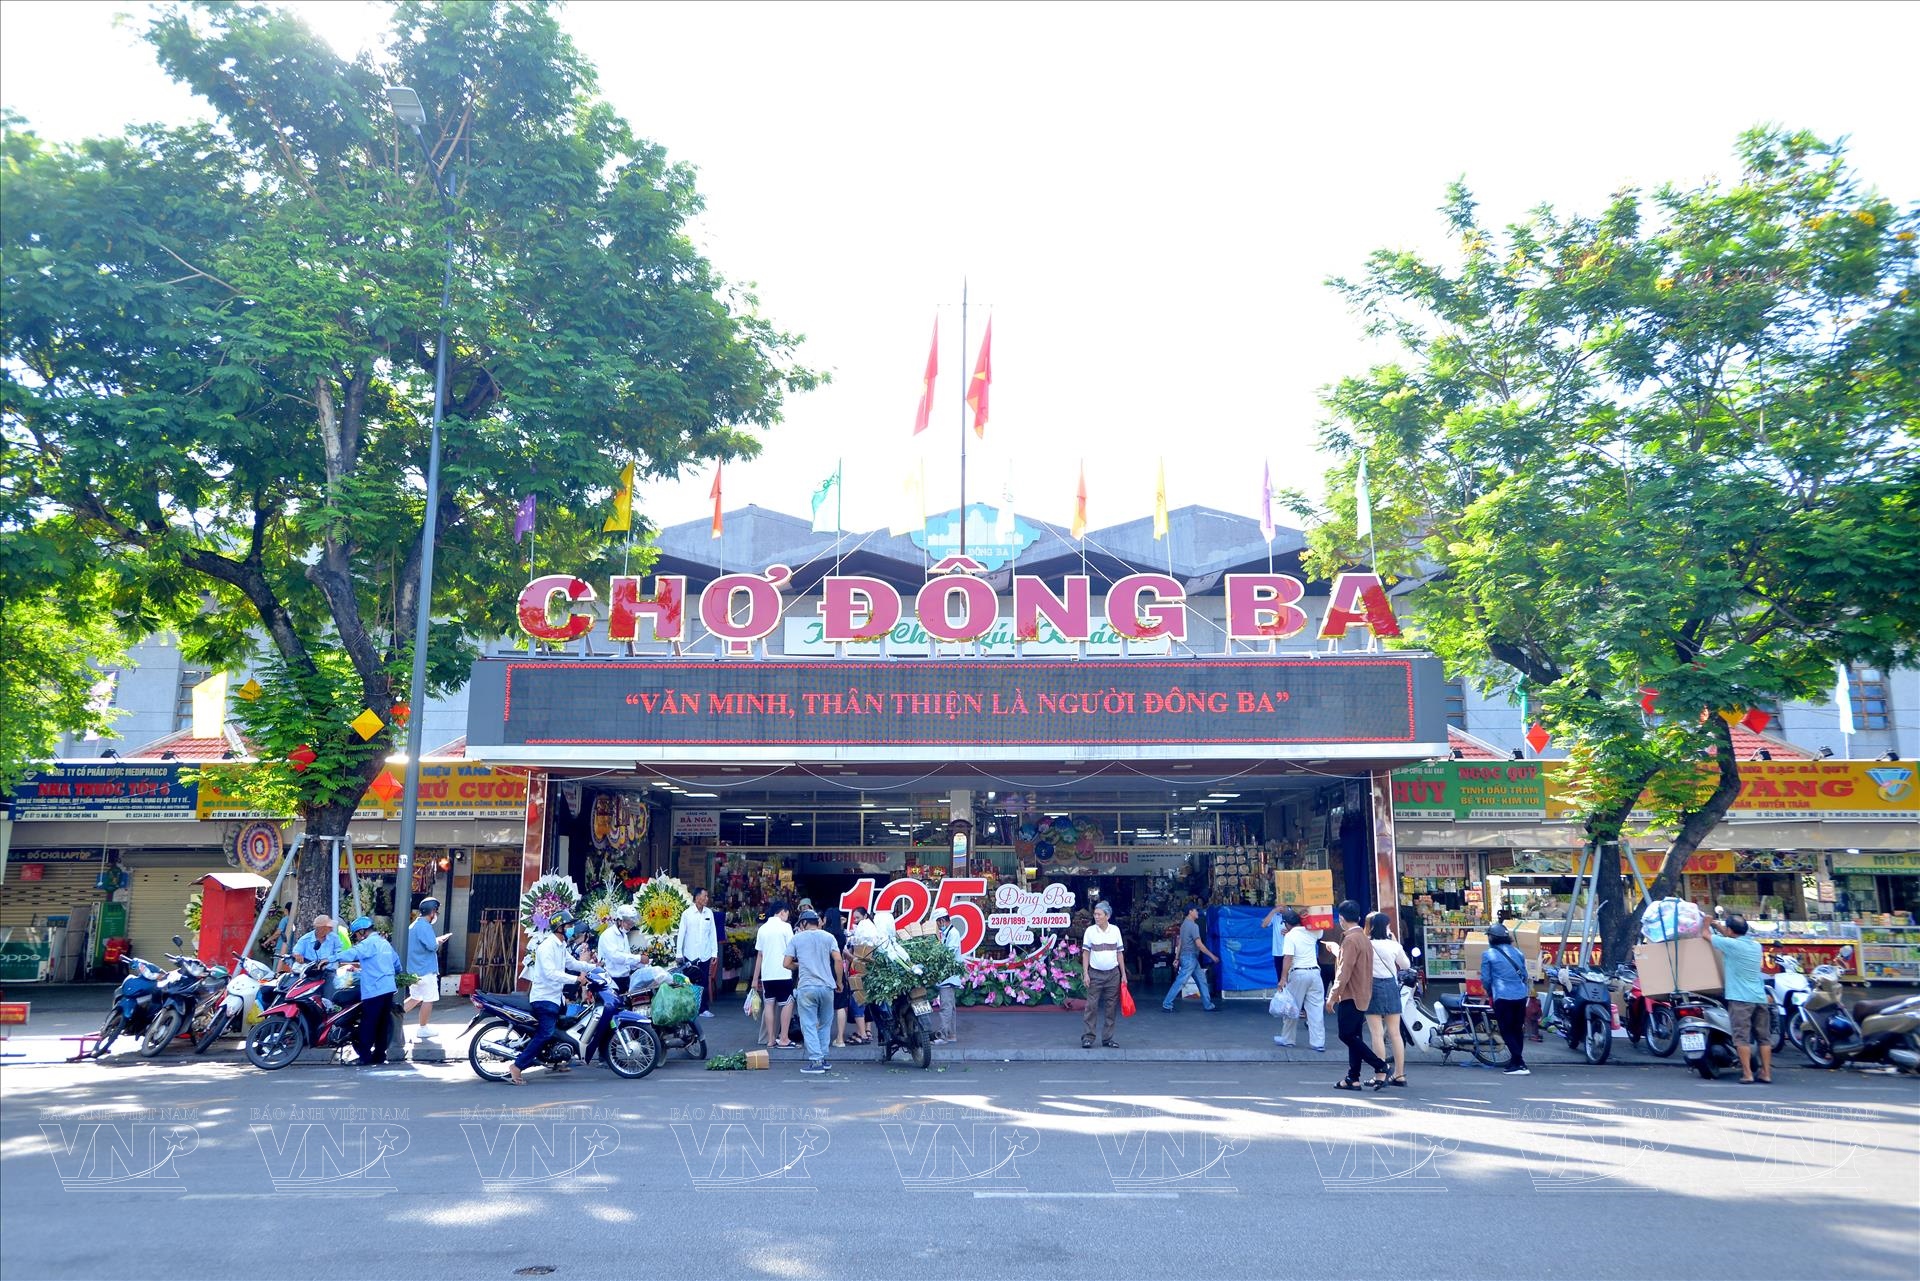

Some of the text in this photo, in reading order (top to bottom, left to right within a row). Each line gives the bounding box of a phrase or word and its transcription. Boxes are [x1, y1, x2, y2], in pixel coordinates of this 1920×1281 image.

[517, 554, 1402, 655] CHỢ ĐÔNG BA
[708, 693, 795, 719] MINH,
[802, 688, 883, 714] THÂN
[890, 690, 983, 720] THIỆN
[992, 688, 1029, 714] LÀ
[1038, 687, 1136, 714] NGƯỜI
[1143, 686, 1229, 713] ĐÔNG
[75, 778, 125, 796] THUỐC
[1459, 767, 1502, 783] NGỌC
[998, 886, 1073, 916] Đông Ba
[840, 879, 987, 956] 125
[991, 916, 1068, 925] 23/8/1899 23/8/2024
